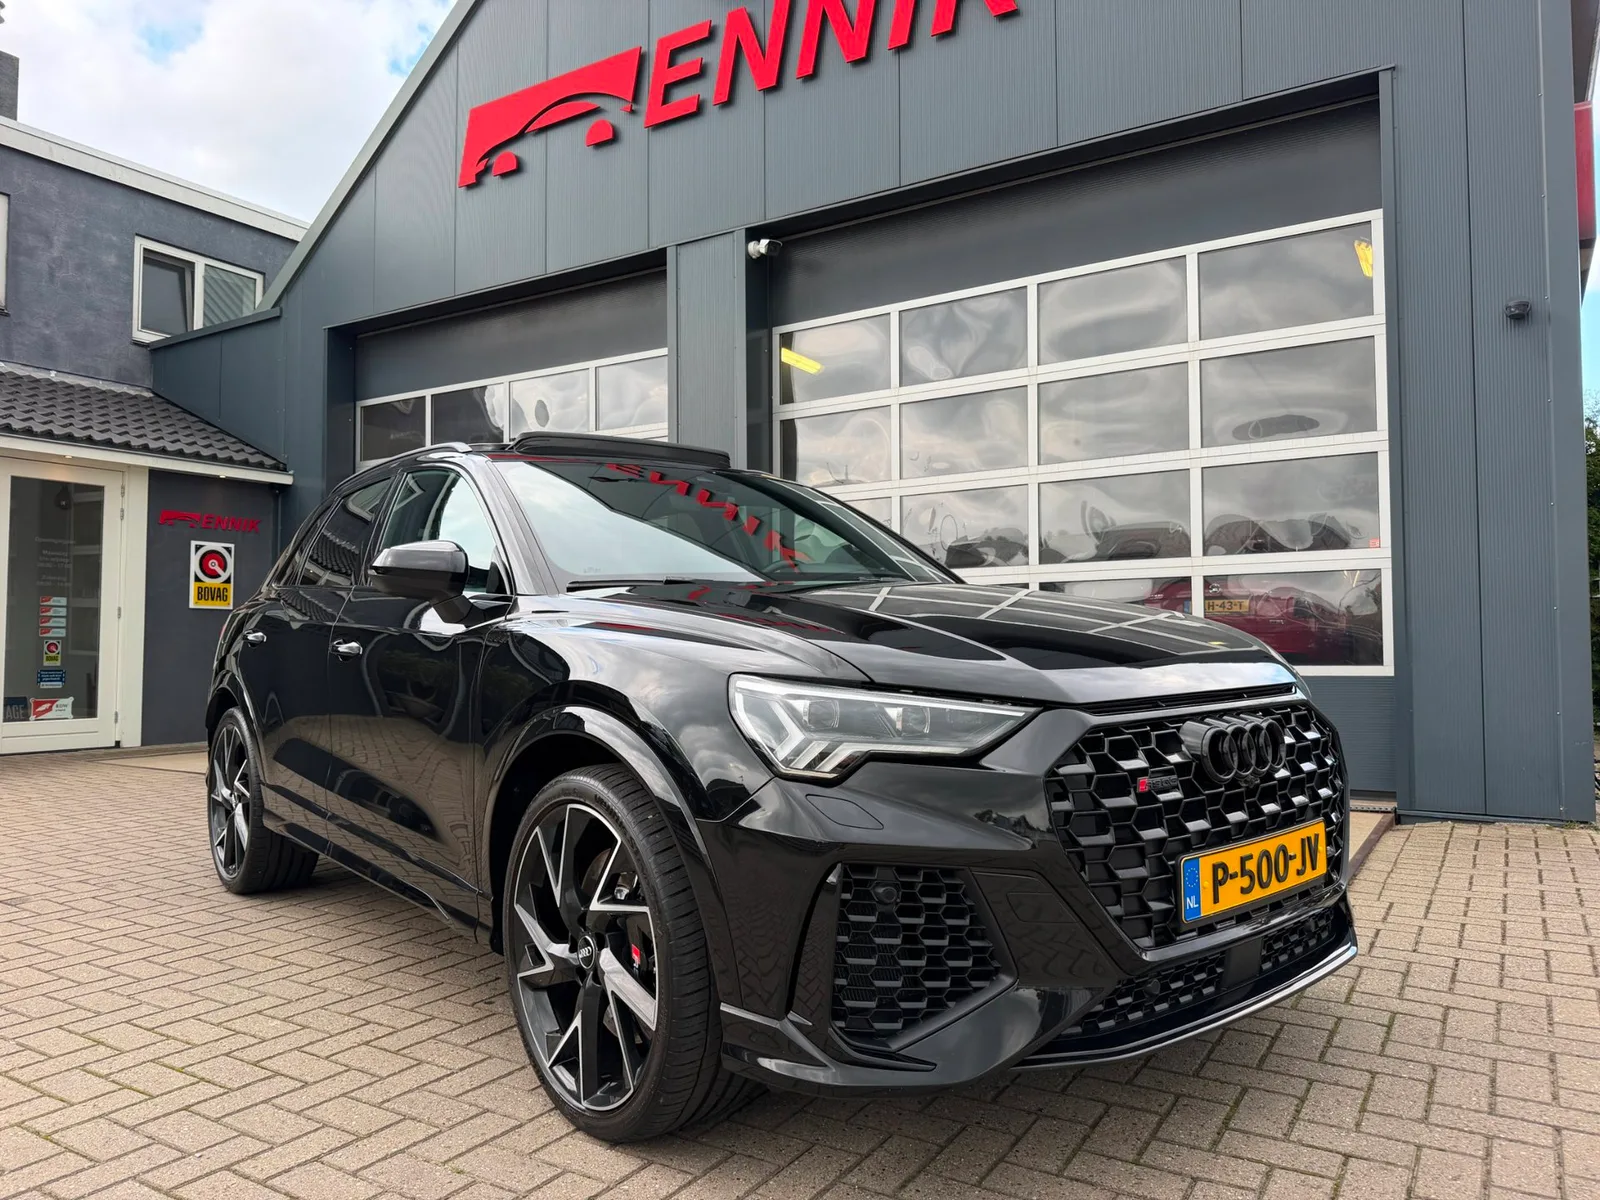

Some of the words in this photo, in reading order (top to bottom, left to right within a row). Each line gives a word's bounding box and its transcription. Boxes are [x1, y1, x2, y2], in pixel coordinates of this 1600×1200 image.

[197, 586, 228, 602] BOVAG
[1205, 600, 1245, 612] H-43-T
[1212, 833, 1319, 904] P-500-JV
[1186, 895, 1199, 909] NL
